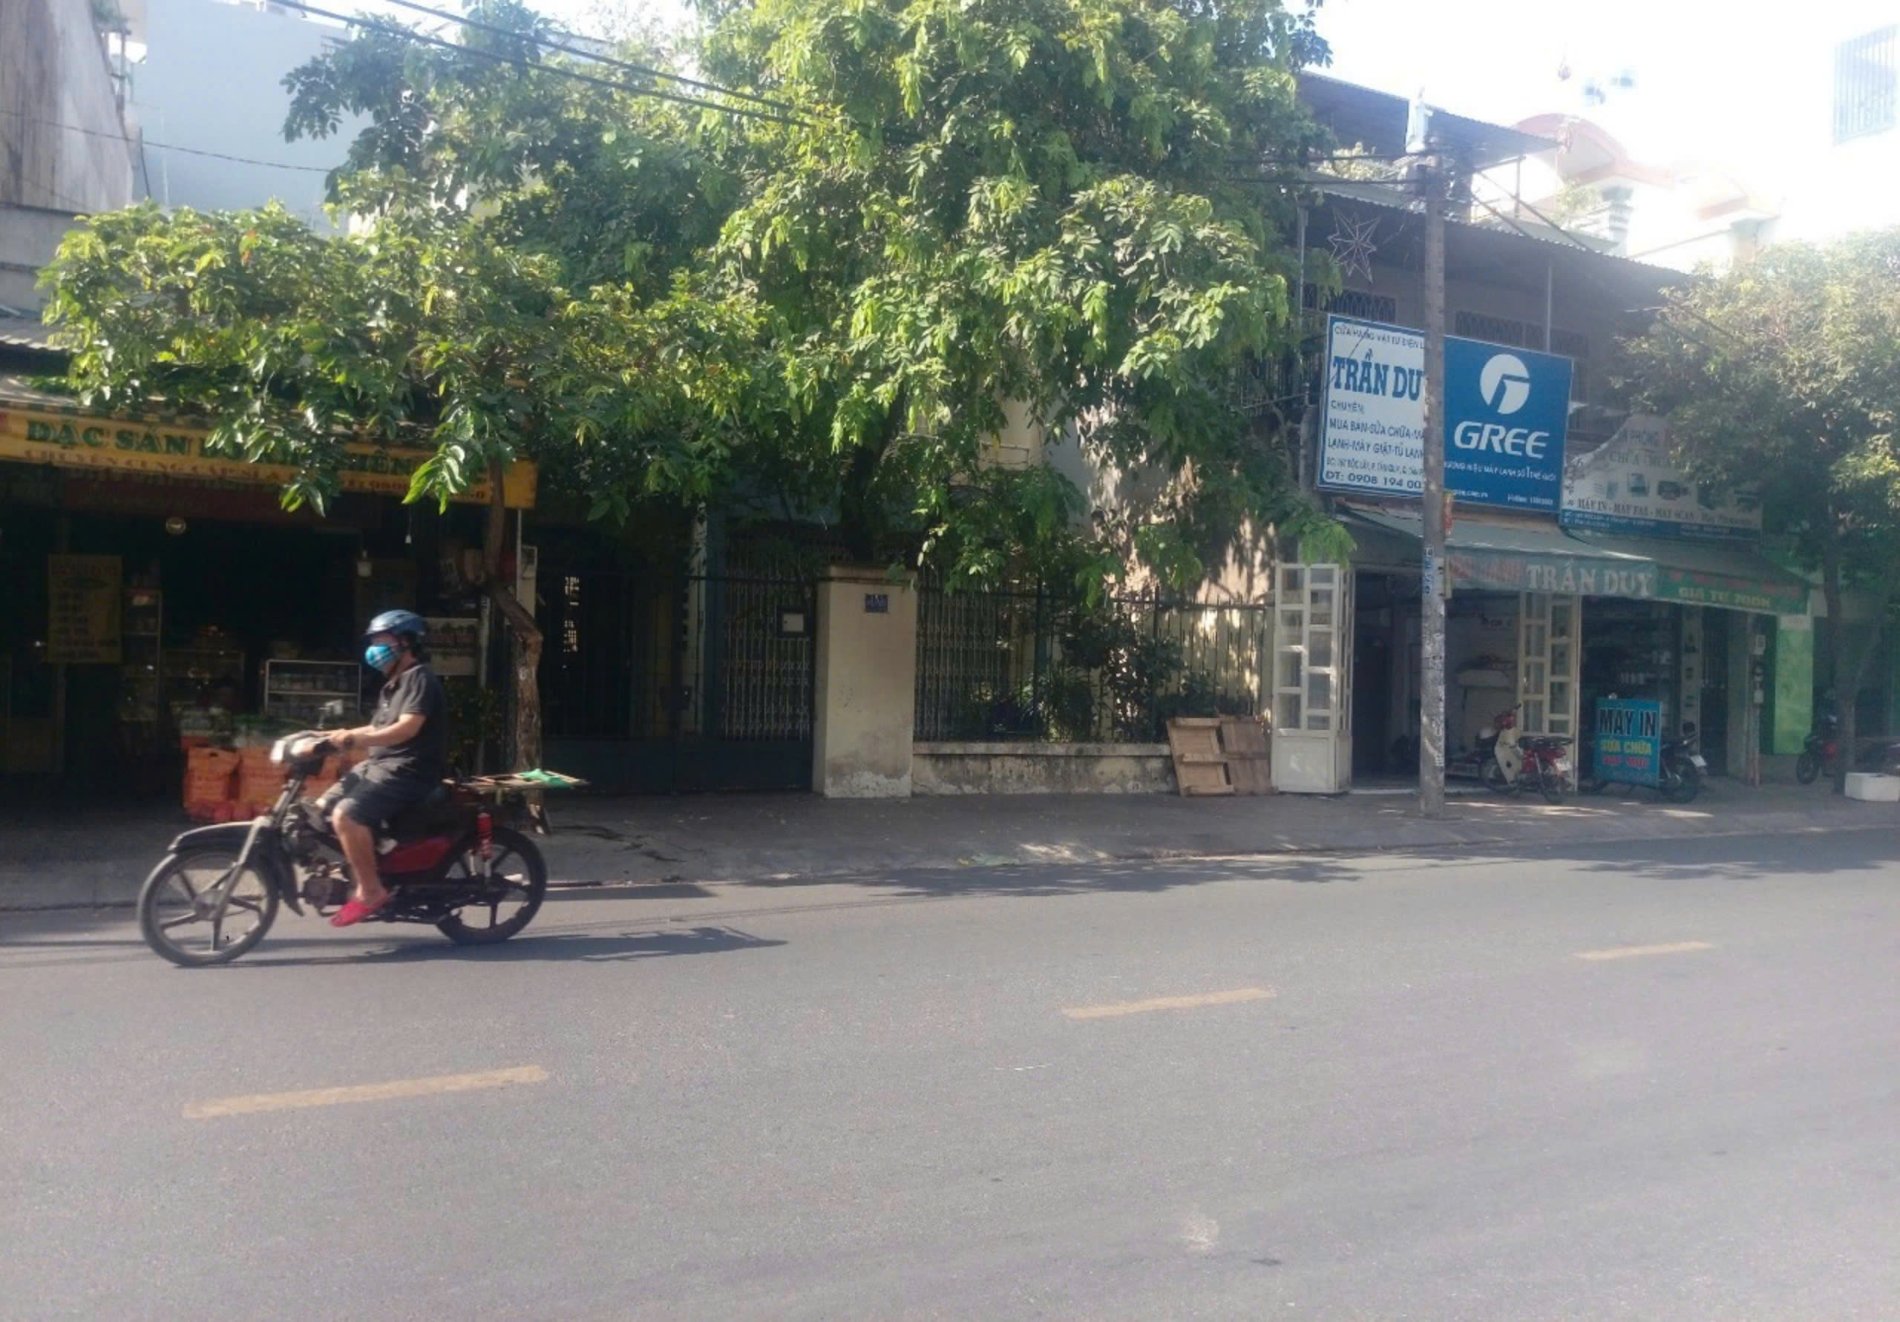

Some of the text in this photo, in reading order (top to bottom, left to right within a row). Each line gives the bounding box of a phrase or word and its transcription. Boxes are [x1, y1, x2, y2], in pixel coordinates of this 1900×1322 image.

[26, 417, 107, 450] ĐẶC
[1329, 418, 1349, 432] MUA
[1454, 420, 1552, 460] GREE
[1348, 472, 1378, 485] 0908
[1384, 476, 1404, 487] 194
[1602, 569, 1653, 597] DUY
[1638, 709, 1658, 738] IN
